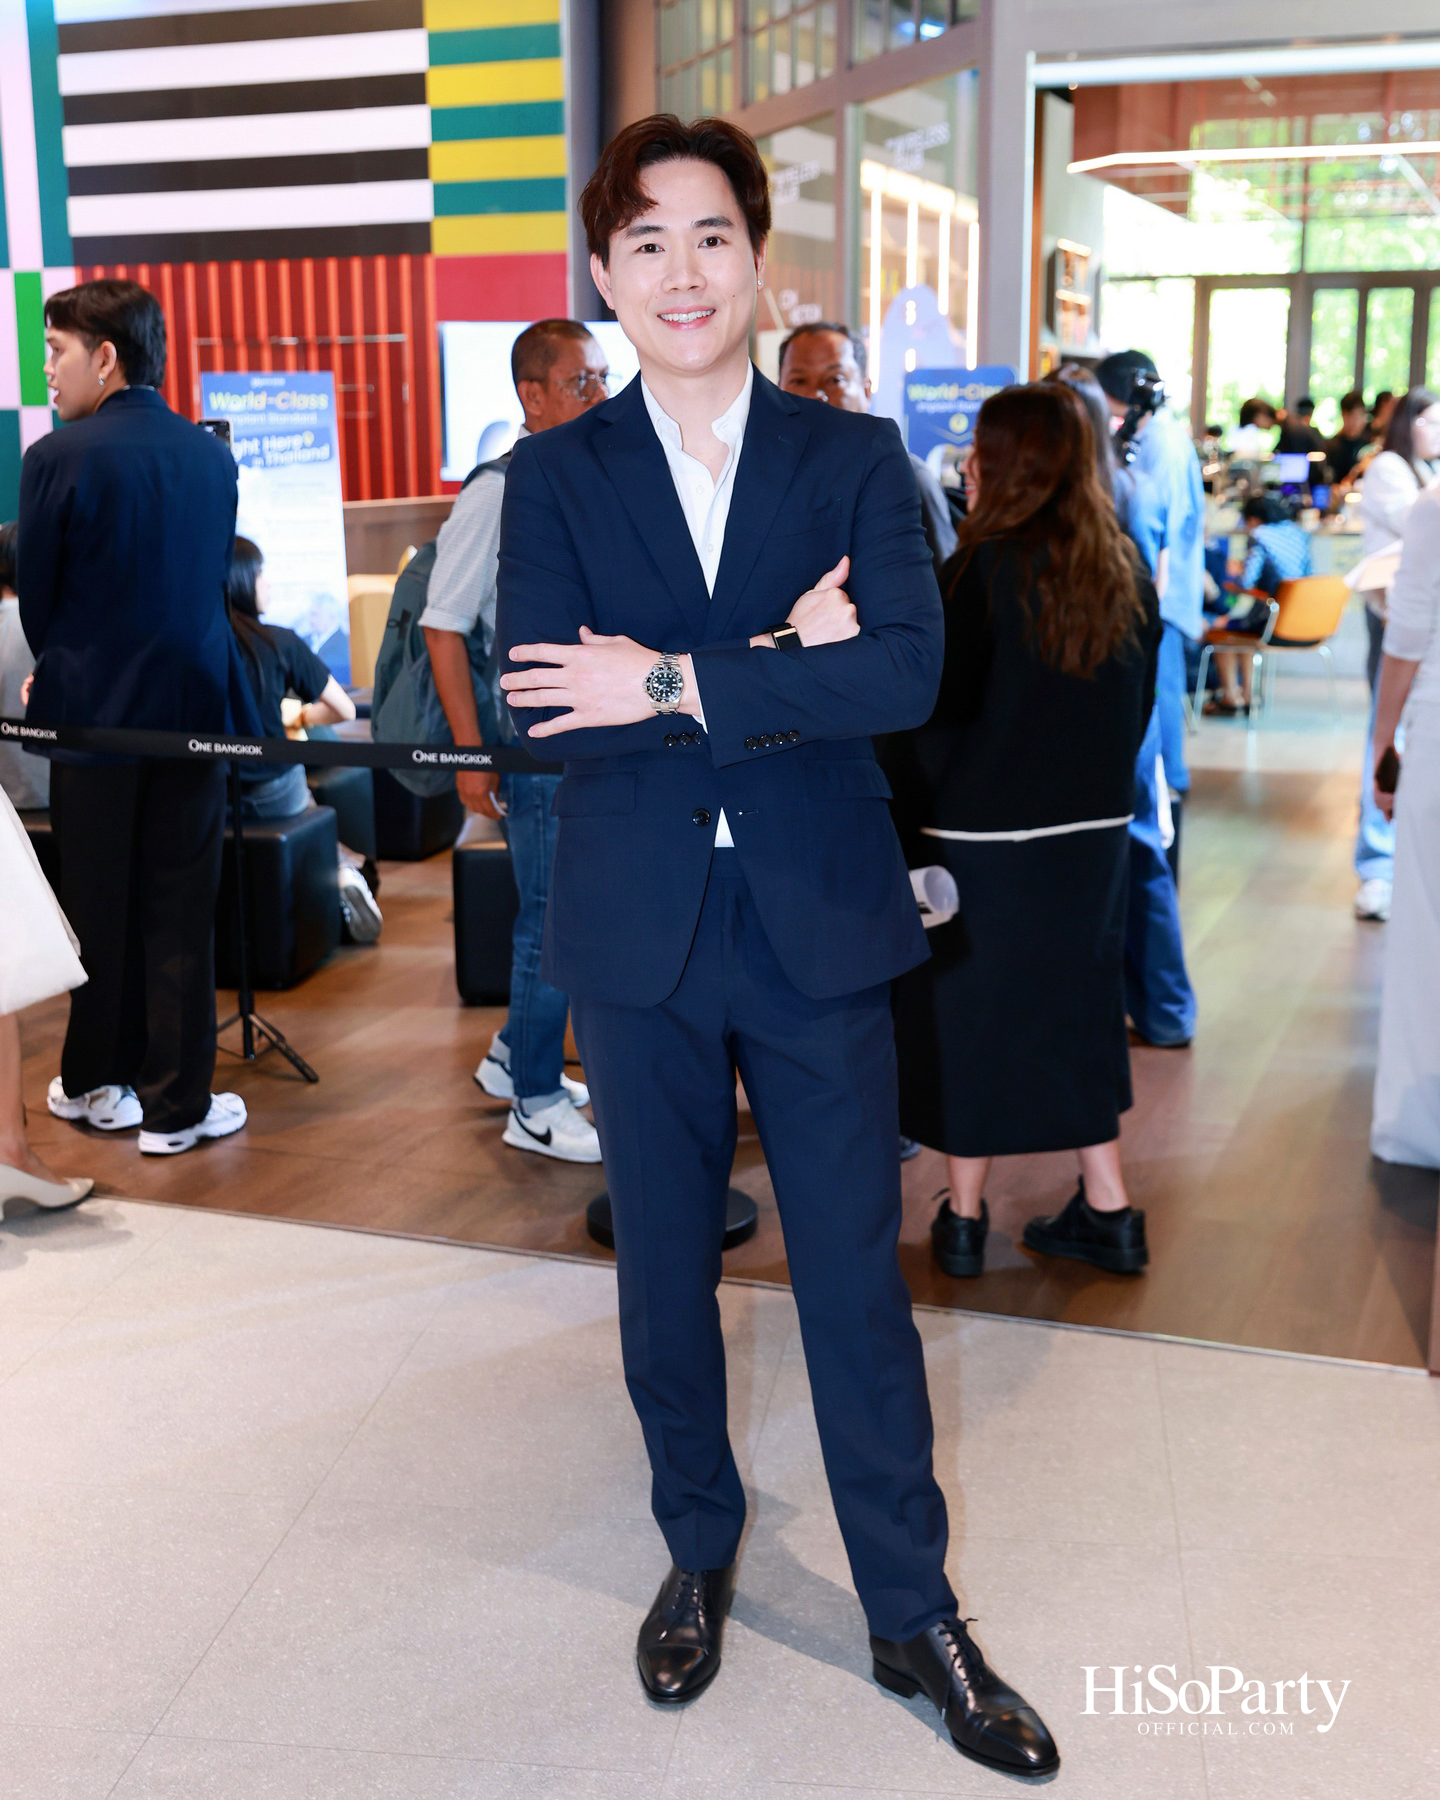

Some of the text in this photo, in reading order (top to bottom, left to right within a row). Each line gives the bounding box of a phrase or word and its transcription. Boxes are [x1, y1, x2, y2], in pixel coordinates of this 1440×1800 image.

[209, 391, 329, 411] World-Class
[232, 437, 260, 462] ght
[264, 444, 330, 466] Thailand
[19, 727, 57, 740] BANGKOK
[214, 743, 263, 756] BANGKOK
[440, 753, 492, 765] BANGKOK
